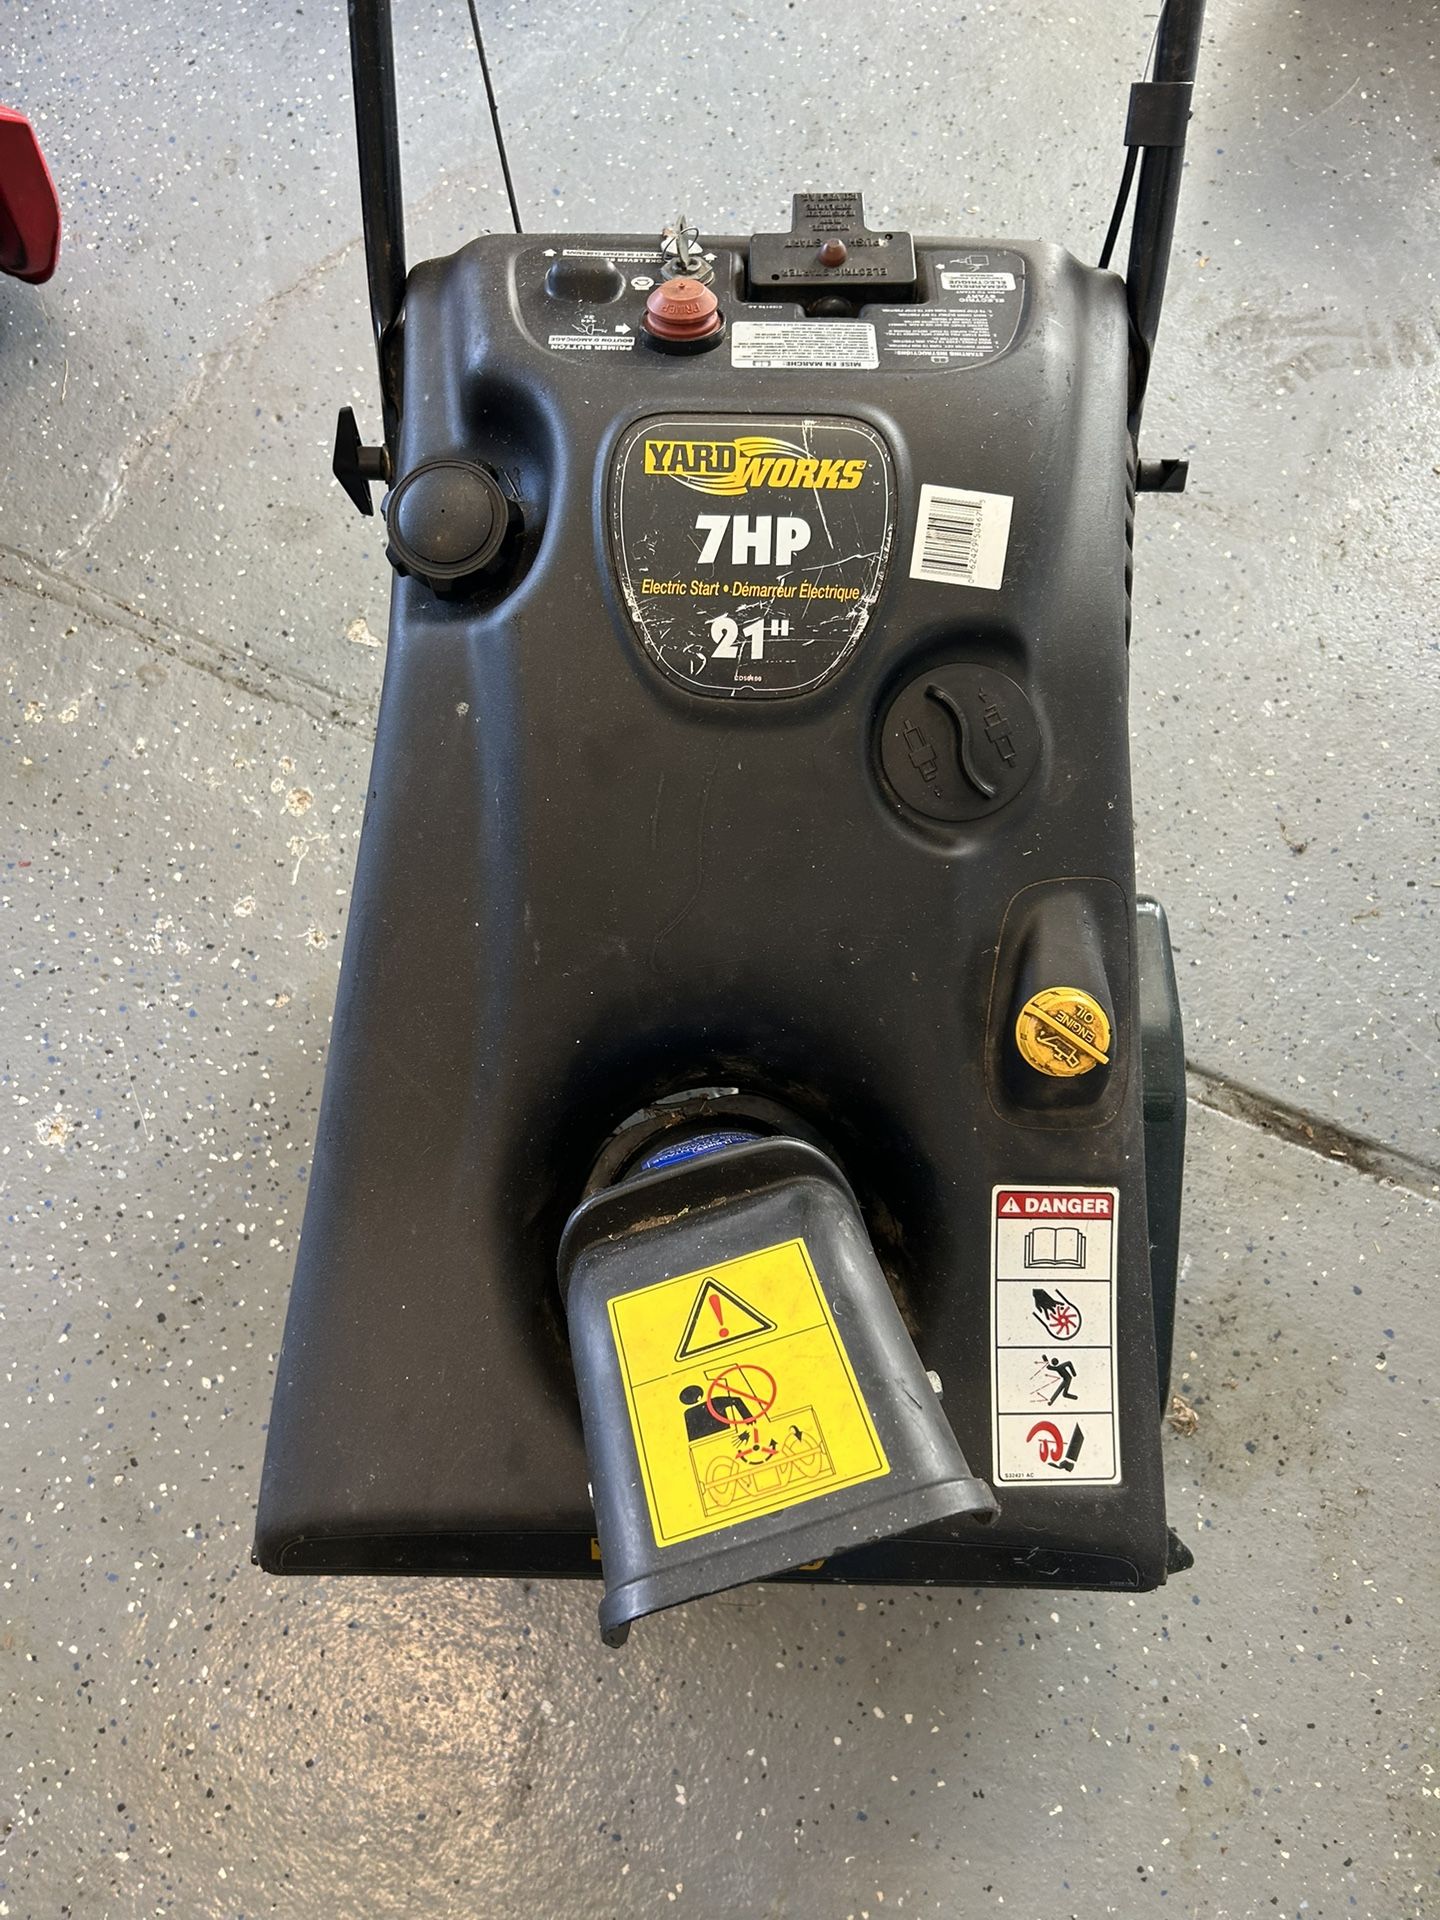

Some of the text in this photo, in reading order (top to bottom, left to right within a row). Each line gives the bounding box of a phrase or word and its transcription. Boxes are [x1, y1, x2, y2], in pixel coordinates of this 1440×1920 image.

[835, 268, 888, 277] ELECTRIC
[663, 303, 701, 314] PRIMER
[695, 514, 812, 566] 7HP
[641, 579, 860, 603] Electric Start Démarreur Électrique
[1076, 1004, 1095, 1024] OIL
[1055, 1010, 1096, 1043] ENGINE
[1025, 1197, 1109, 1214] DANGER
